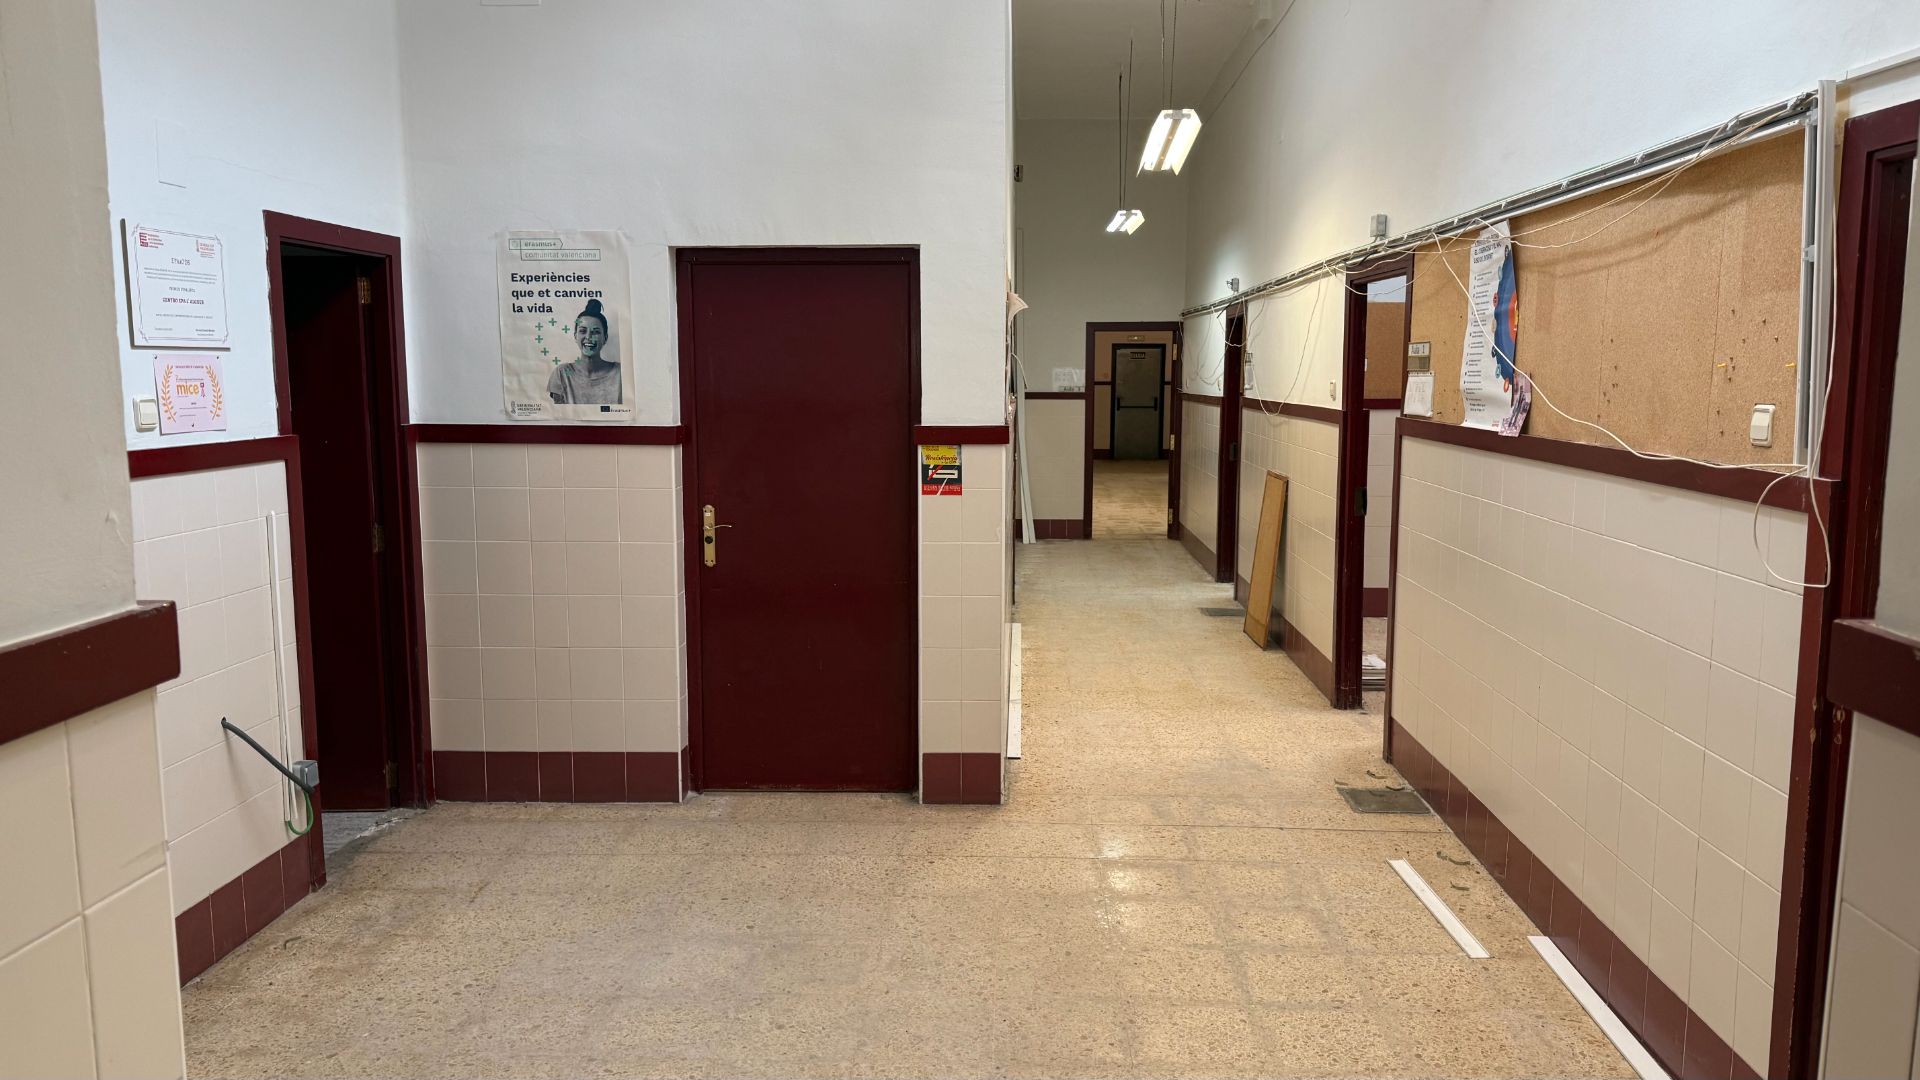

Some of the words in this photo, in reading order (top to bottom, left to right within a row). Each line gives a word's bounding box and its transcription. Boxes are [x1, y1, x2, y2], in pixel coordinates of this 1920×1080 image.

[511, 272, 591, 284] Experiències
[511, 289, 534, 300] que
[538, 288, 551, 298] et
[554, 288, 603, 298] canvien
[512, 302, 524, 313] la
[527, 302, 553, 313] vida
[176, 383, 200, 396] mice
